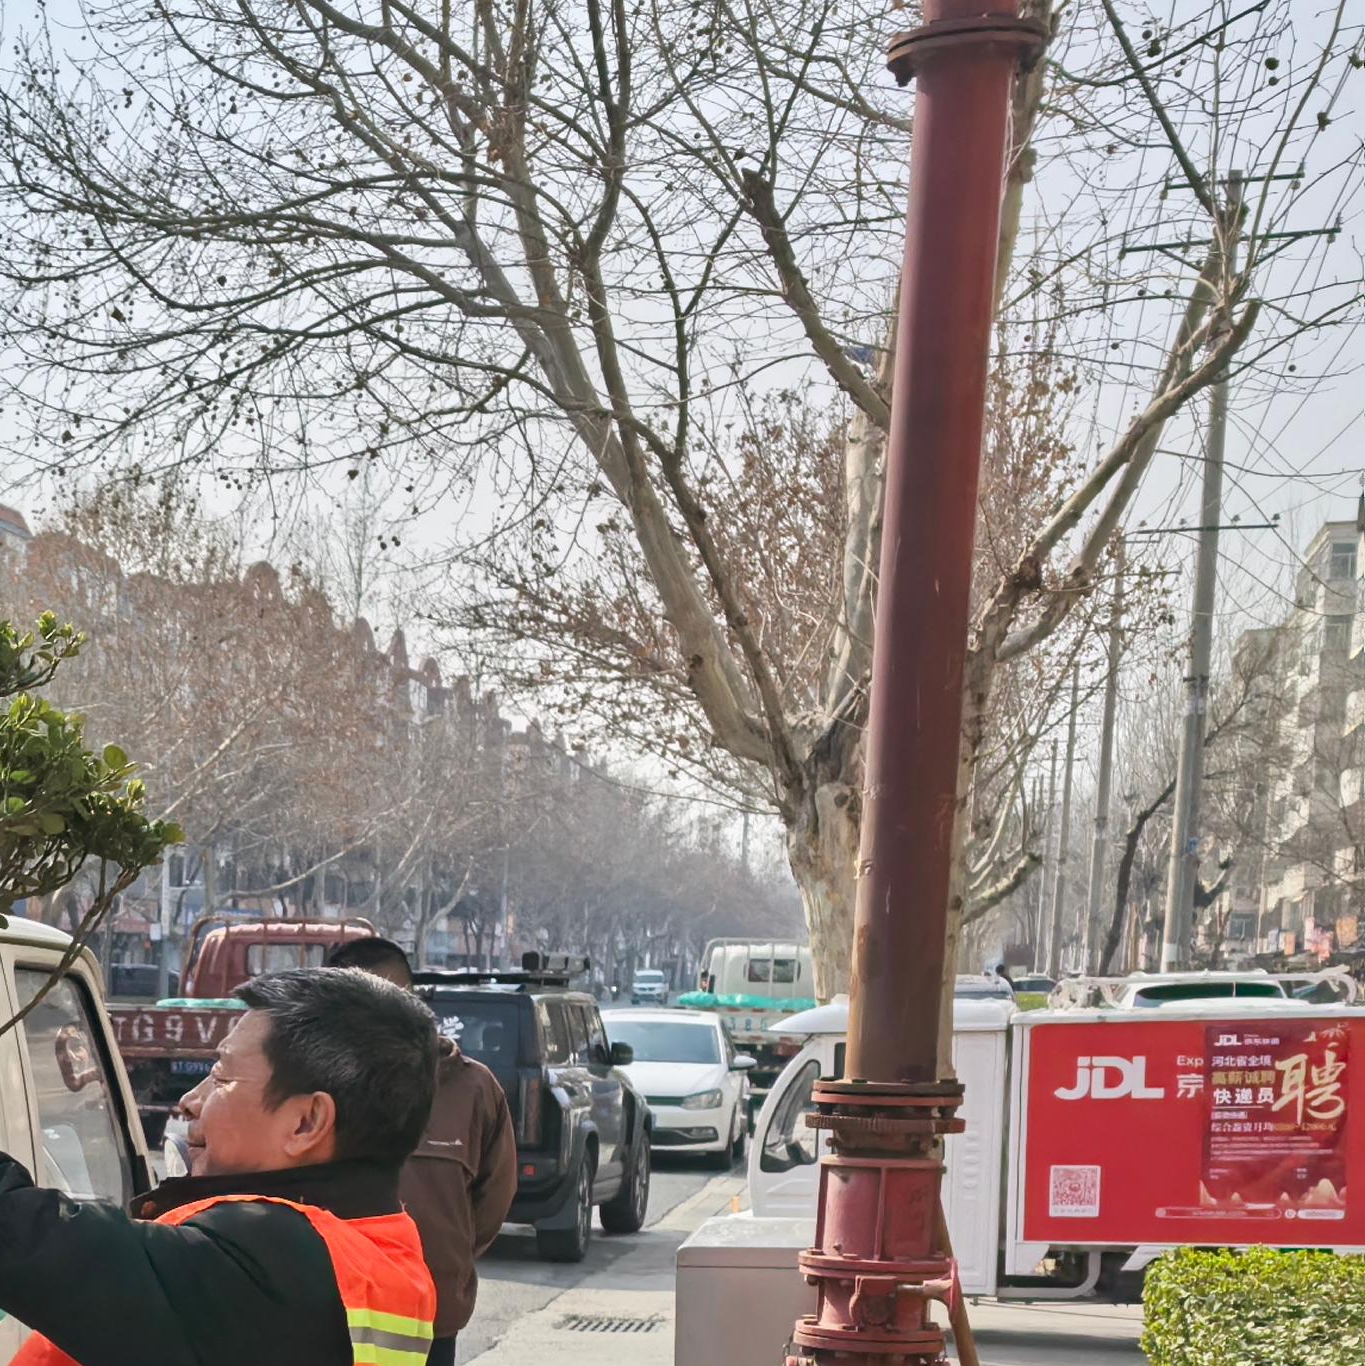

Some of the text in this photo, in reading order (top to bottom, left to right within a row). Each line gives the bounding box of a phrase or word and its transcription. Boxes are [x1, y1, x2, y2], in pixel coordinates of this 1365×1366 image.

[1213, 1034, 1242, 1046] JDL
[1177, 1055, 1204, 1068] Exp
[1054, 1055, 1165, 1100] JDL
[1213, 1087, 1275, 1104] 快递员
